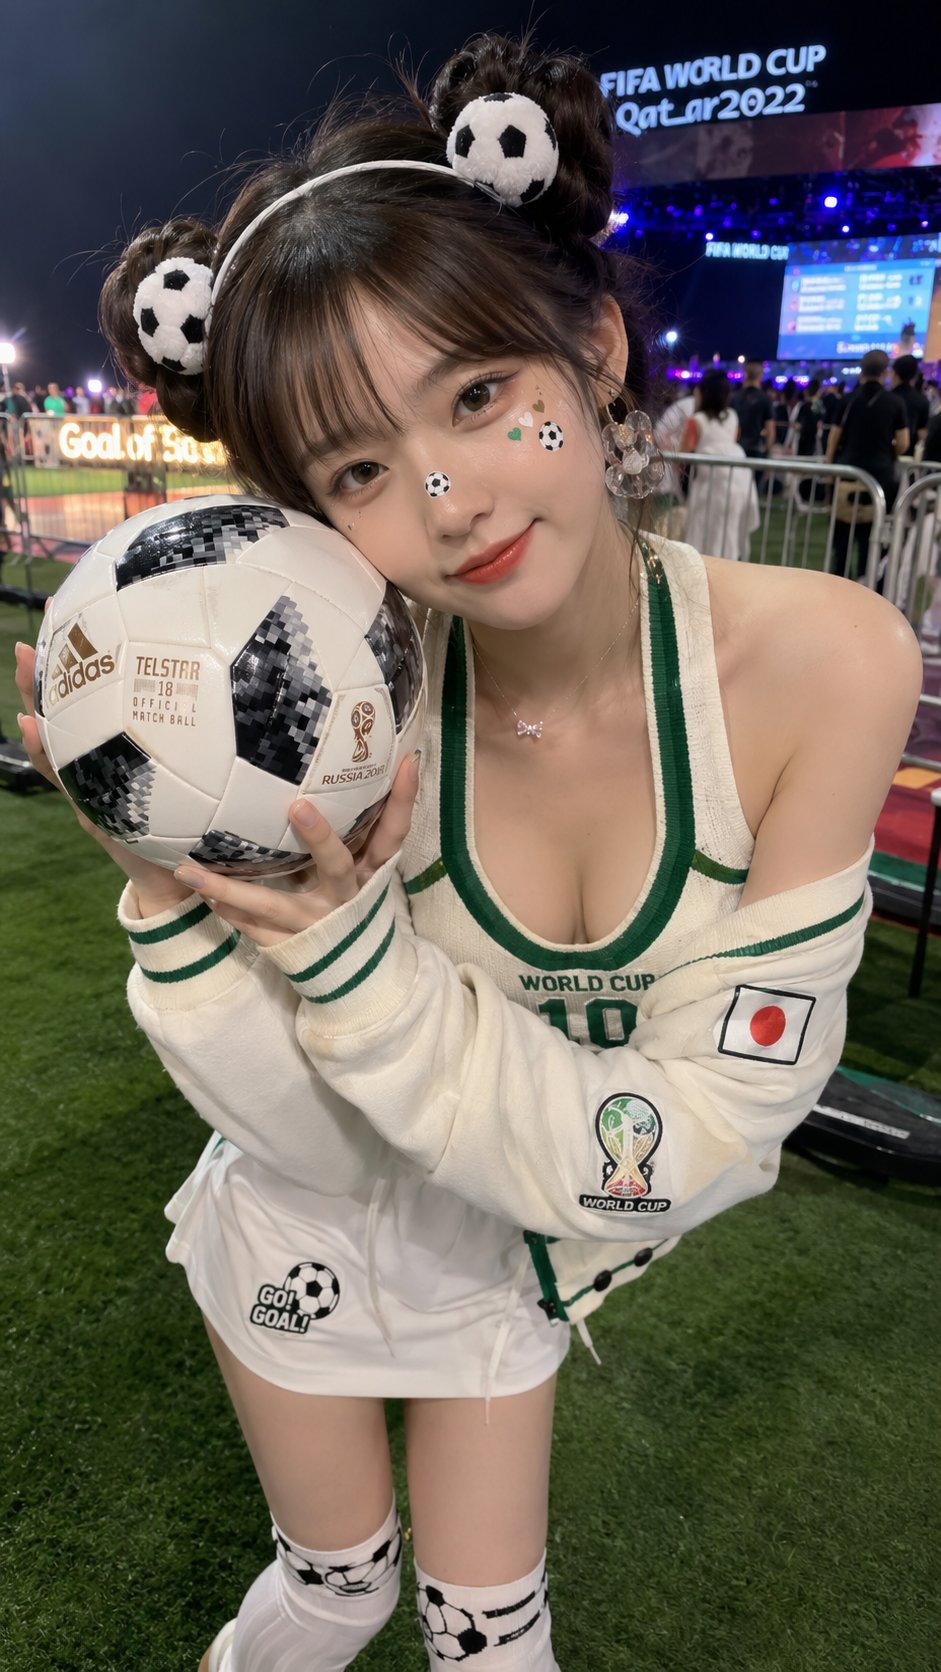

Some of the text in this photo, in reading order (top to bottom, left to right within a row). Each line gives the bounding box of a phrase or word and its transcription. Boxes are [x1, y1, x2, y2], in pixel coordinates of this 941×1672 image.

[599, 44, 827, 98] FIFA WORLD CUP
[705, 241, 731, 257] FIFA
[732, 242, 770, 260] WORLD
[59, 422, 125, 460] Goal
[126, 424, 154, 462] of
[50, 654, 116, 706] adidas
[158, 680, 174, 697] 18
[132, 696, 197, 713] OFFICIL
[132, 710, 197, 727] MATCH BALL
[321, 771, 363, 785] RUSSIA
[518, 973, 656, 993] WORLD CUP
[537, 997, 638, 1049] 10
[582, 1197, 668, 1212] WORLD CUP
[259, 1285, 296, 1311] GO!
[251, 1304, 310, 1333] GOAL!
